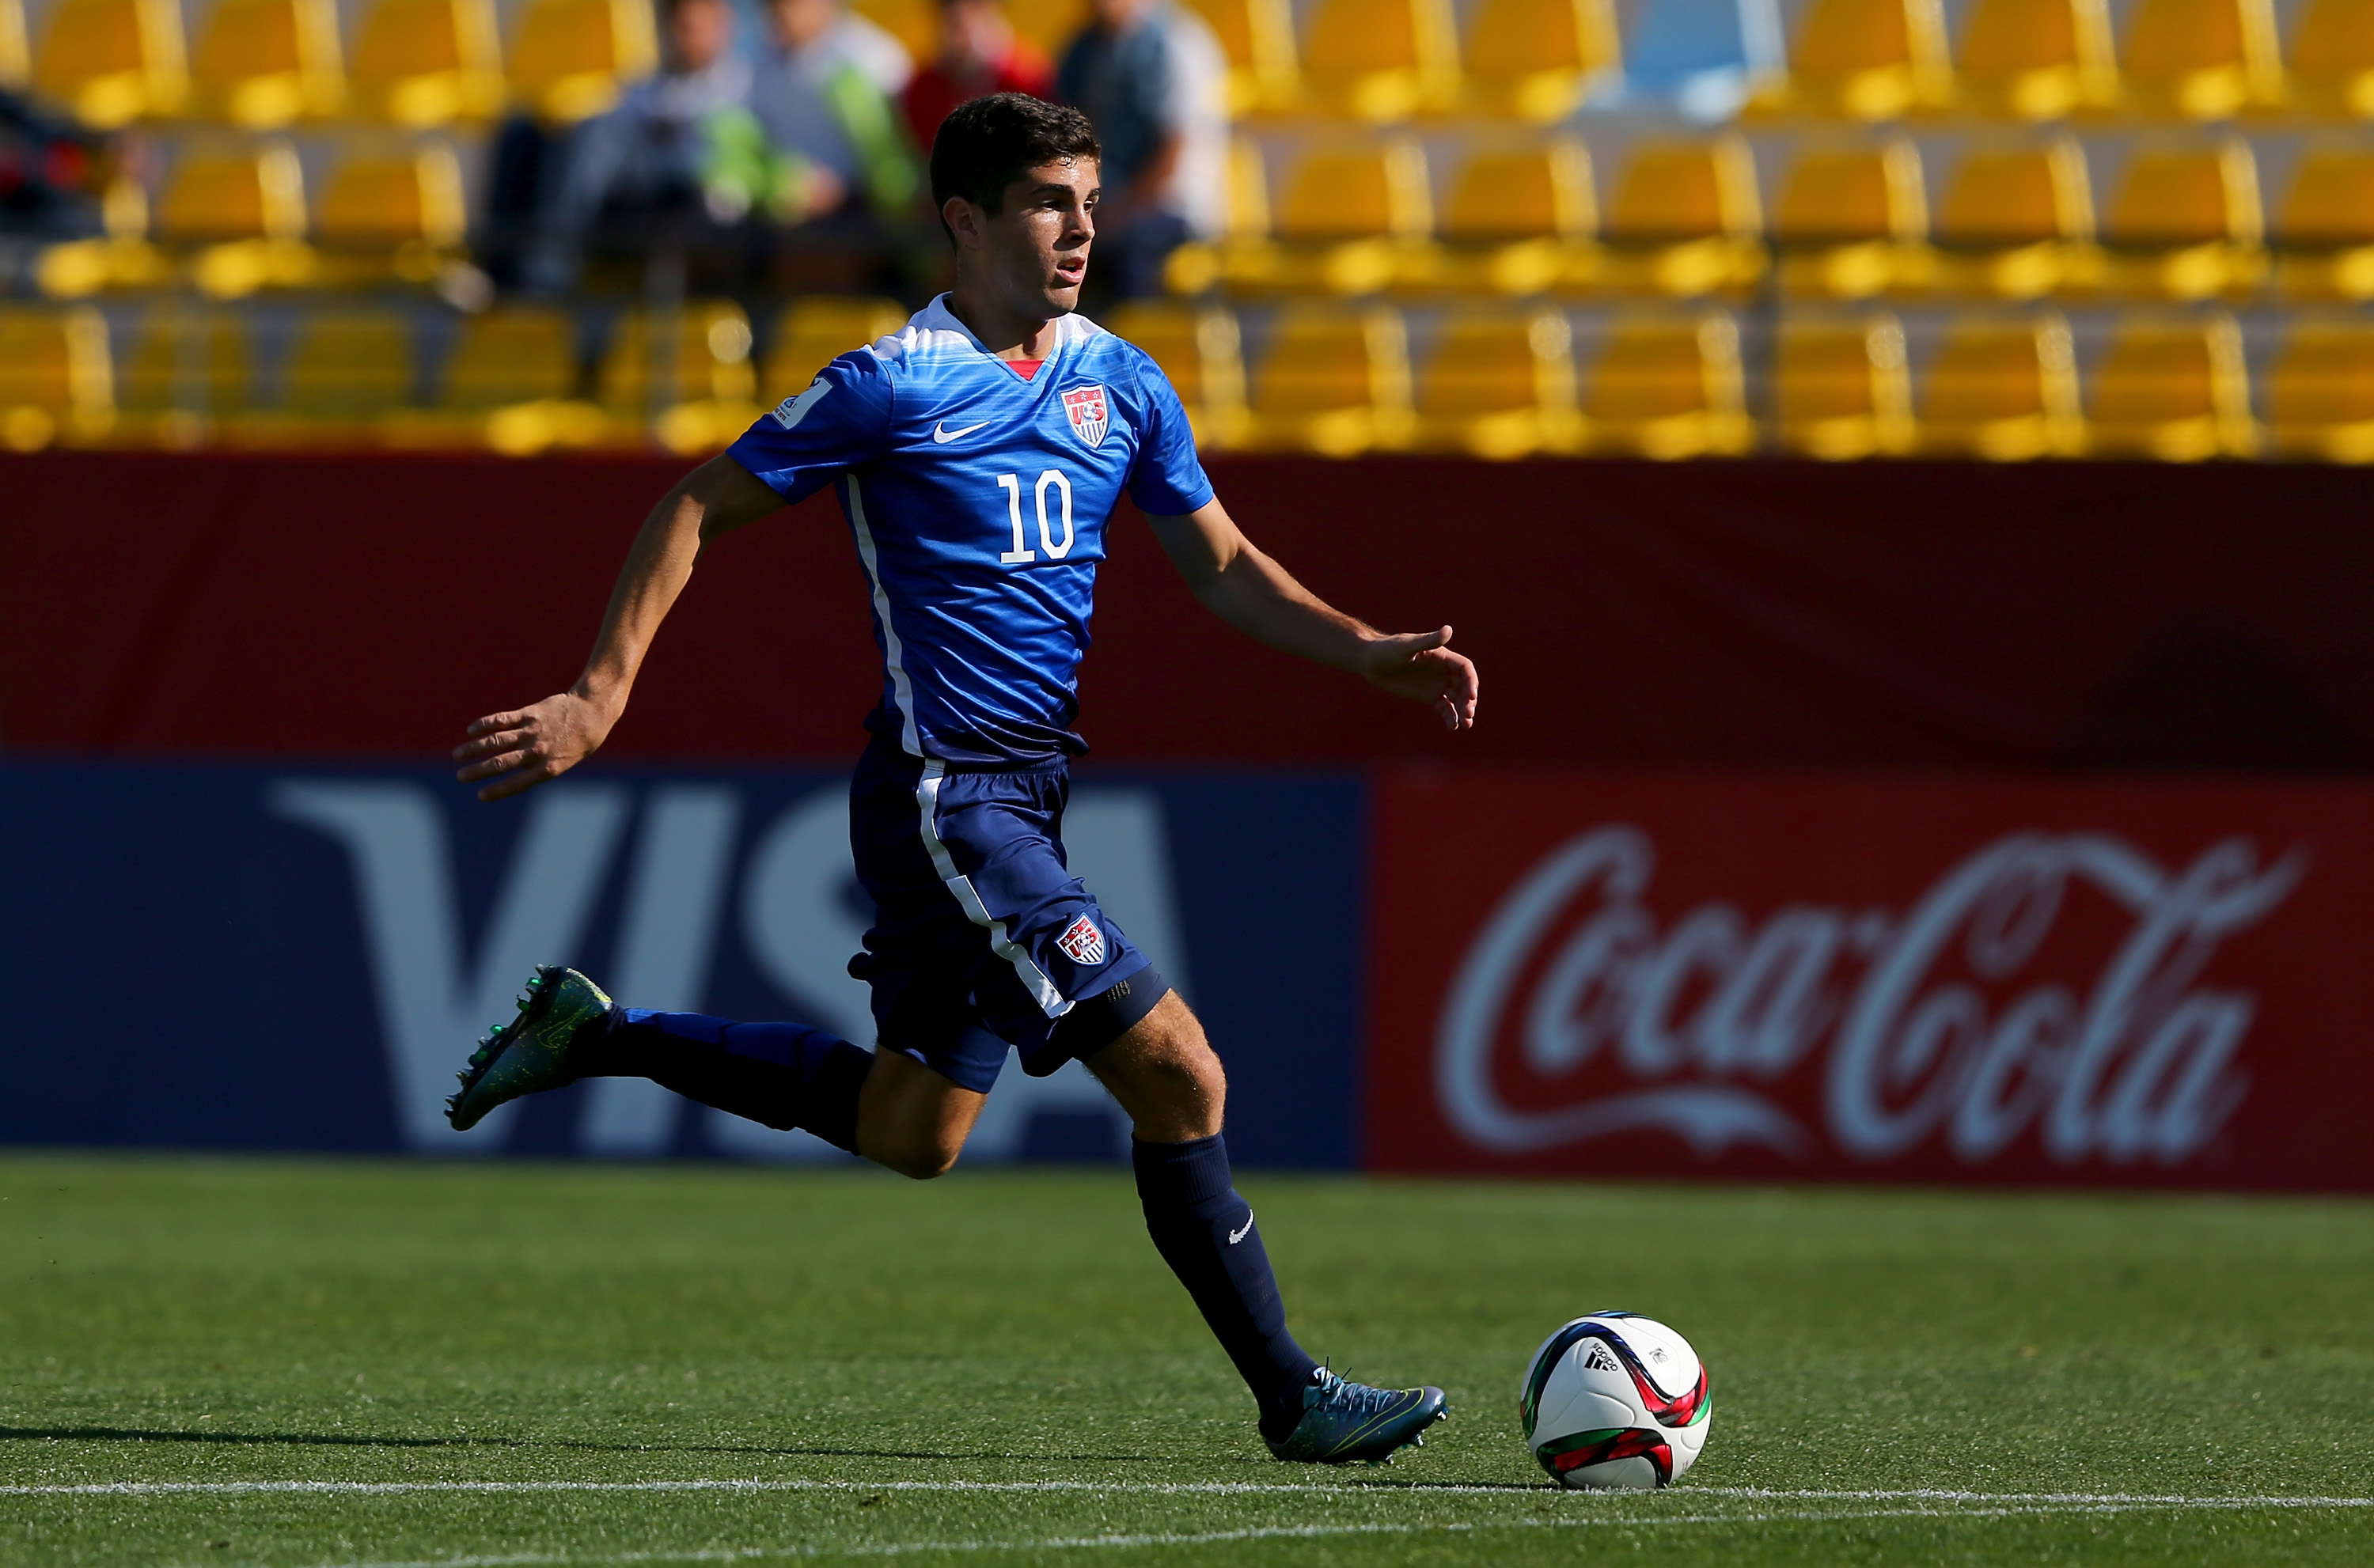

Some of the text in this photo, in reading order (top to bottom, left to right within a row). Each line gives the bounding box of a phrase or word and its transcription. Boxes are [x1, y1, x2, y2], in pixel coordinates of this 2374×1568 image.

[997, 468, 1075, 563] 10
[272, 782, 1193, 1158] VISA
[1590, 1343, 1617, 1371] adidas
